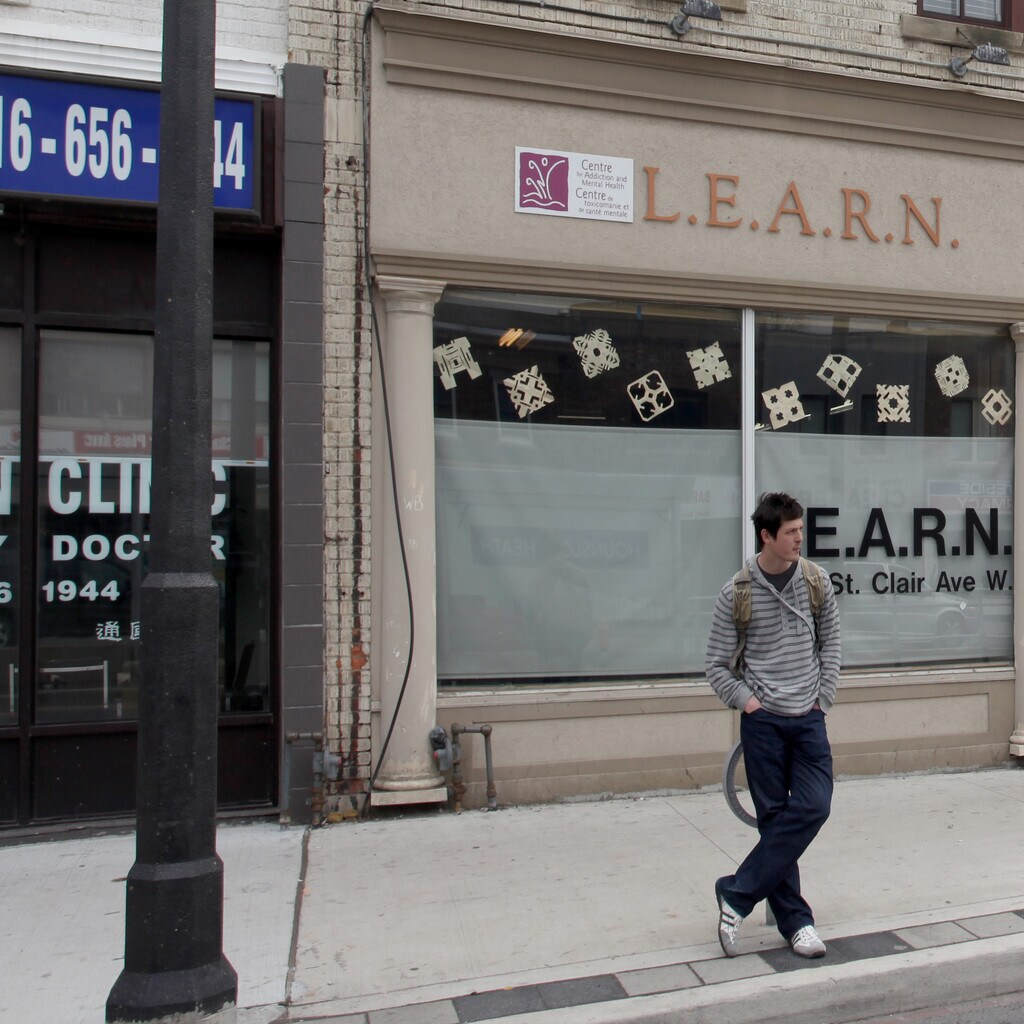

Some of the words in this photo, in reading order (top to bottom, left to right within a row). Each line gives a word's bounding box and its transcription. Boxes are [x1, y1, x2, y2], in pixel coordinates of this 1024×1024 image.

[581, 159, 613, 173] Centre
[584, 171, 614, 181] Addiction
[581, 179, 604, 188] Mental
[605, 181, 625, 190] Health
[575, 187, 606, 201] Centre
[584, 200, 621, 209] toxicomanie
[642, 166, 960, 250] L.E.A.R.N.
[585, 206, 602, 216] santé
[603, 210, 628, 218] mentale
[52, 534, 226, 561] DOCR
[830, 572, 860, 595] St.
[872, 571, 925, 595] Clair
[935, 571, 976, 592] Ave
[986, 570, 1013, 591] W.
[42, 580, 120, 602] 1944
